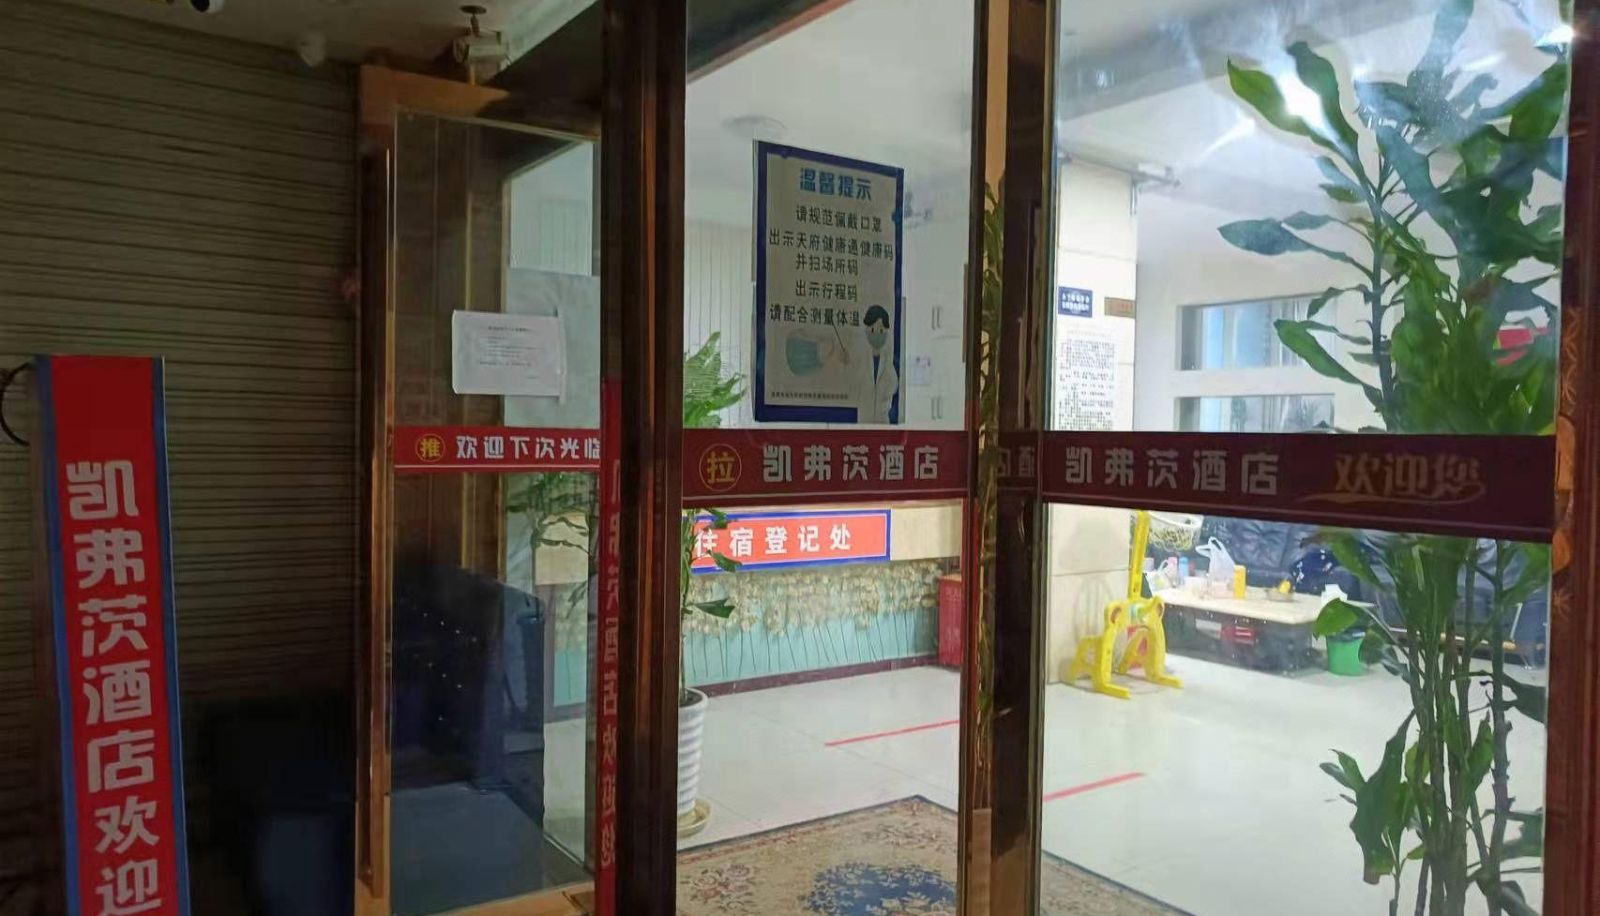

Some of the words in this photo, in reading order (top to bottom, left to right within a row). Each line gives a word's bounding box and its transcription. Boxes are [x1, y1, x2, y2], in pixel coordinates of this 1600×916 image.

[800, 167, 871, 200] 温馨提示
[796, 205, 882, 233] 请规范佩戴口罩
[769, 229, 894, 261] 出示天府健康通健康码
[796, 252, 858, 276] 并扫场所码
[795, 280, 857, 302] 出示行程码
[769, 304, 860, 327] 请配合测量体温
[420, 438, 441, 458] 推
[456, 435, 600, 460] 欢迎下次光临
[707, 451, 736, 484] 拉
[763, 444, 939, 482] 凯弗茨酒店
[1065, 446, 1279, 496] 凯弗茨酒店
[1335, 452, 1488, 501] 欢迎您
[66, 460, 161, 916] 凯弗茨酒店欢迎
